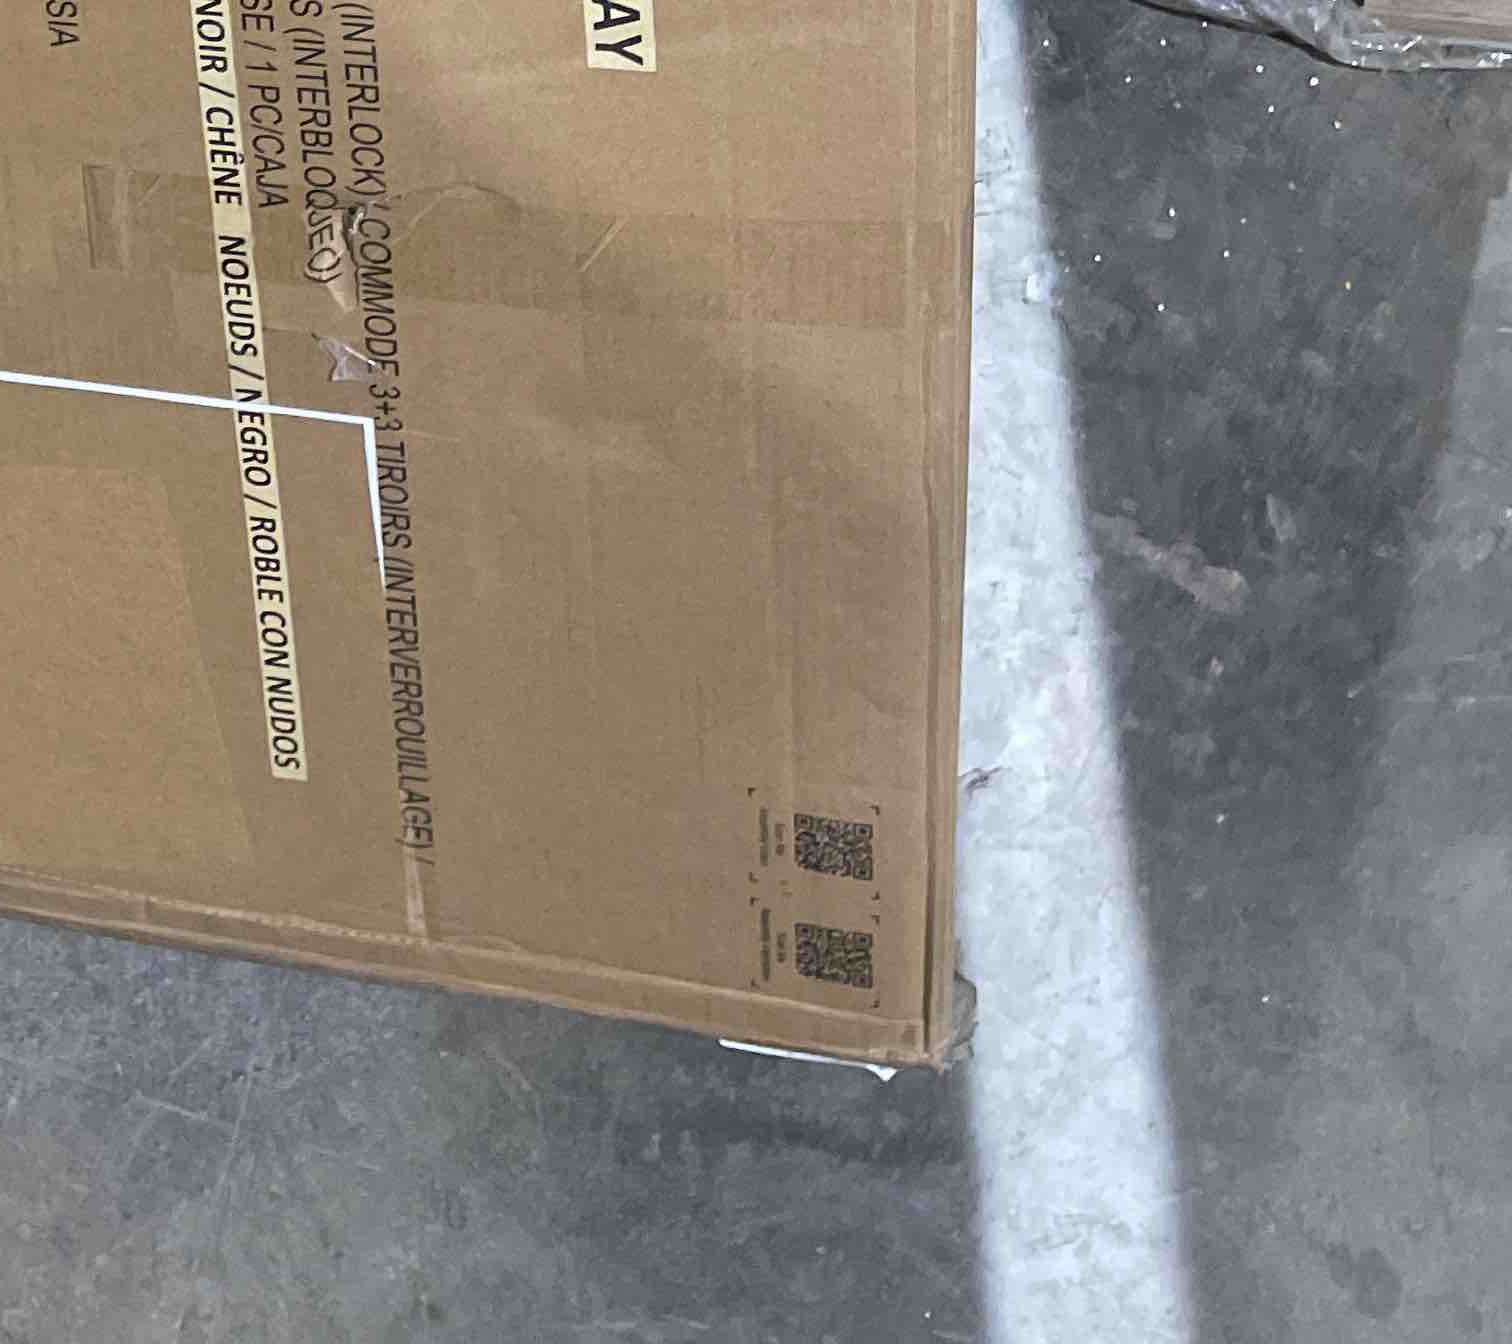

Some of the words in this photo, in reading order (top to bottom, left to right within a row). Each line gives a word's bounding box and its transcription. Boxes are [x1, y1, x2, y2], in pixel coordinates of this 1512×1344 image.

[248, 85, 289, 208] PC/CAJA
[331, 3, 386, 196] (INTERLOCK)
[206, 107, 245, 205] CHÊNE
[219, 236, 257, 356] NOEUDS
[359, 218, 399, 376] COMMODE
[376, 441, 412, 549] TIROIRS
[250, 517, 283, 602] ROBLE
[260, 611, 289, 667] CON
[267, 677, 299, 768] NUDOS
